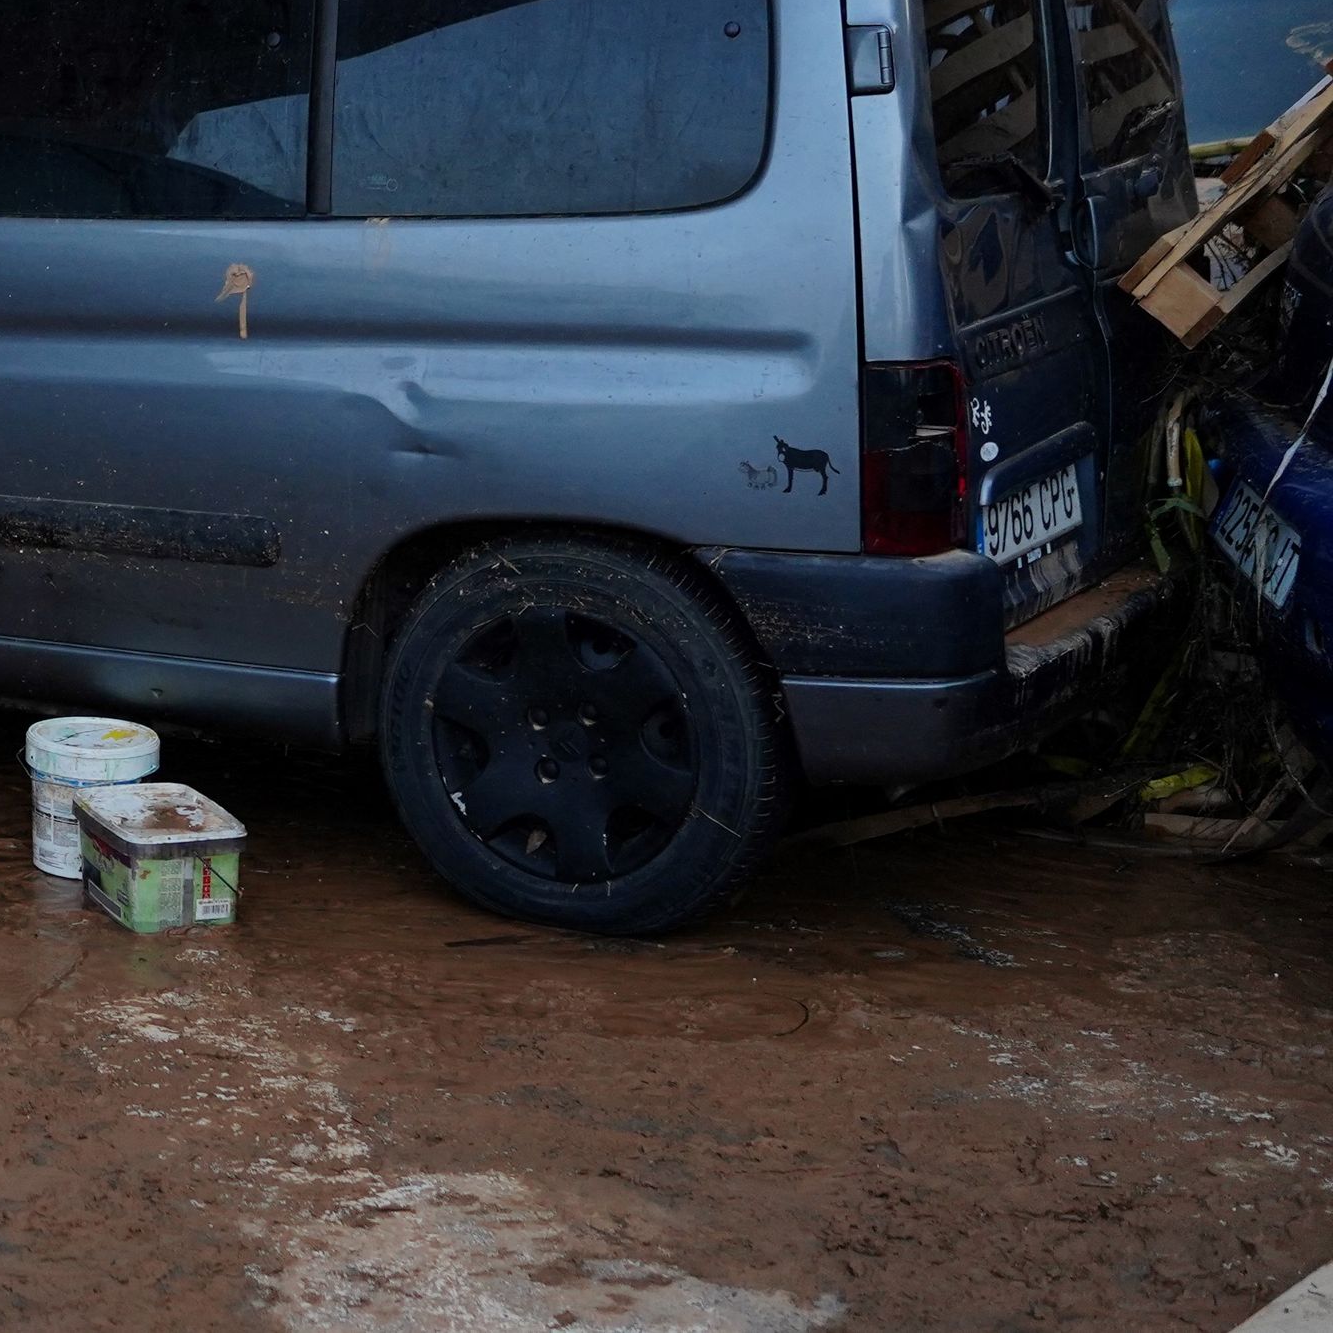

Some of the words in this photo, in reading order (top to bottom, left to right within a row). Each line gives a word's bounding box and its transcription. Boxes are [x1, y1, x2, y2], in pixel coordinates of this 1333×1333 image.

[975, 312, 1048, 369] CITROËN
[987, 488, 1034, 557] 9766
[1039, 467, 1074, 531] CPG
